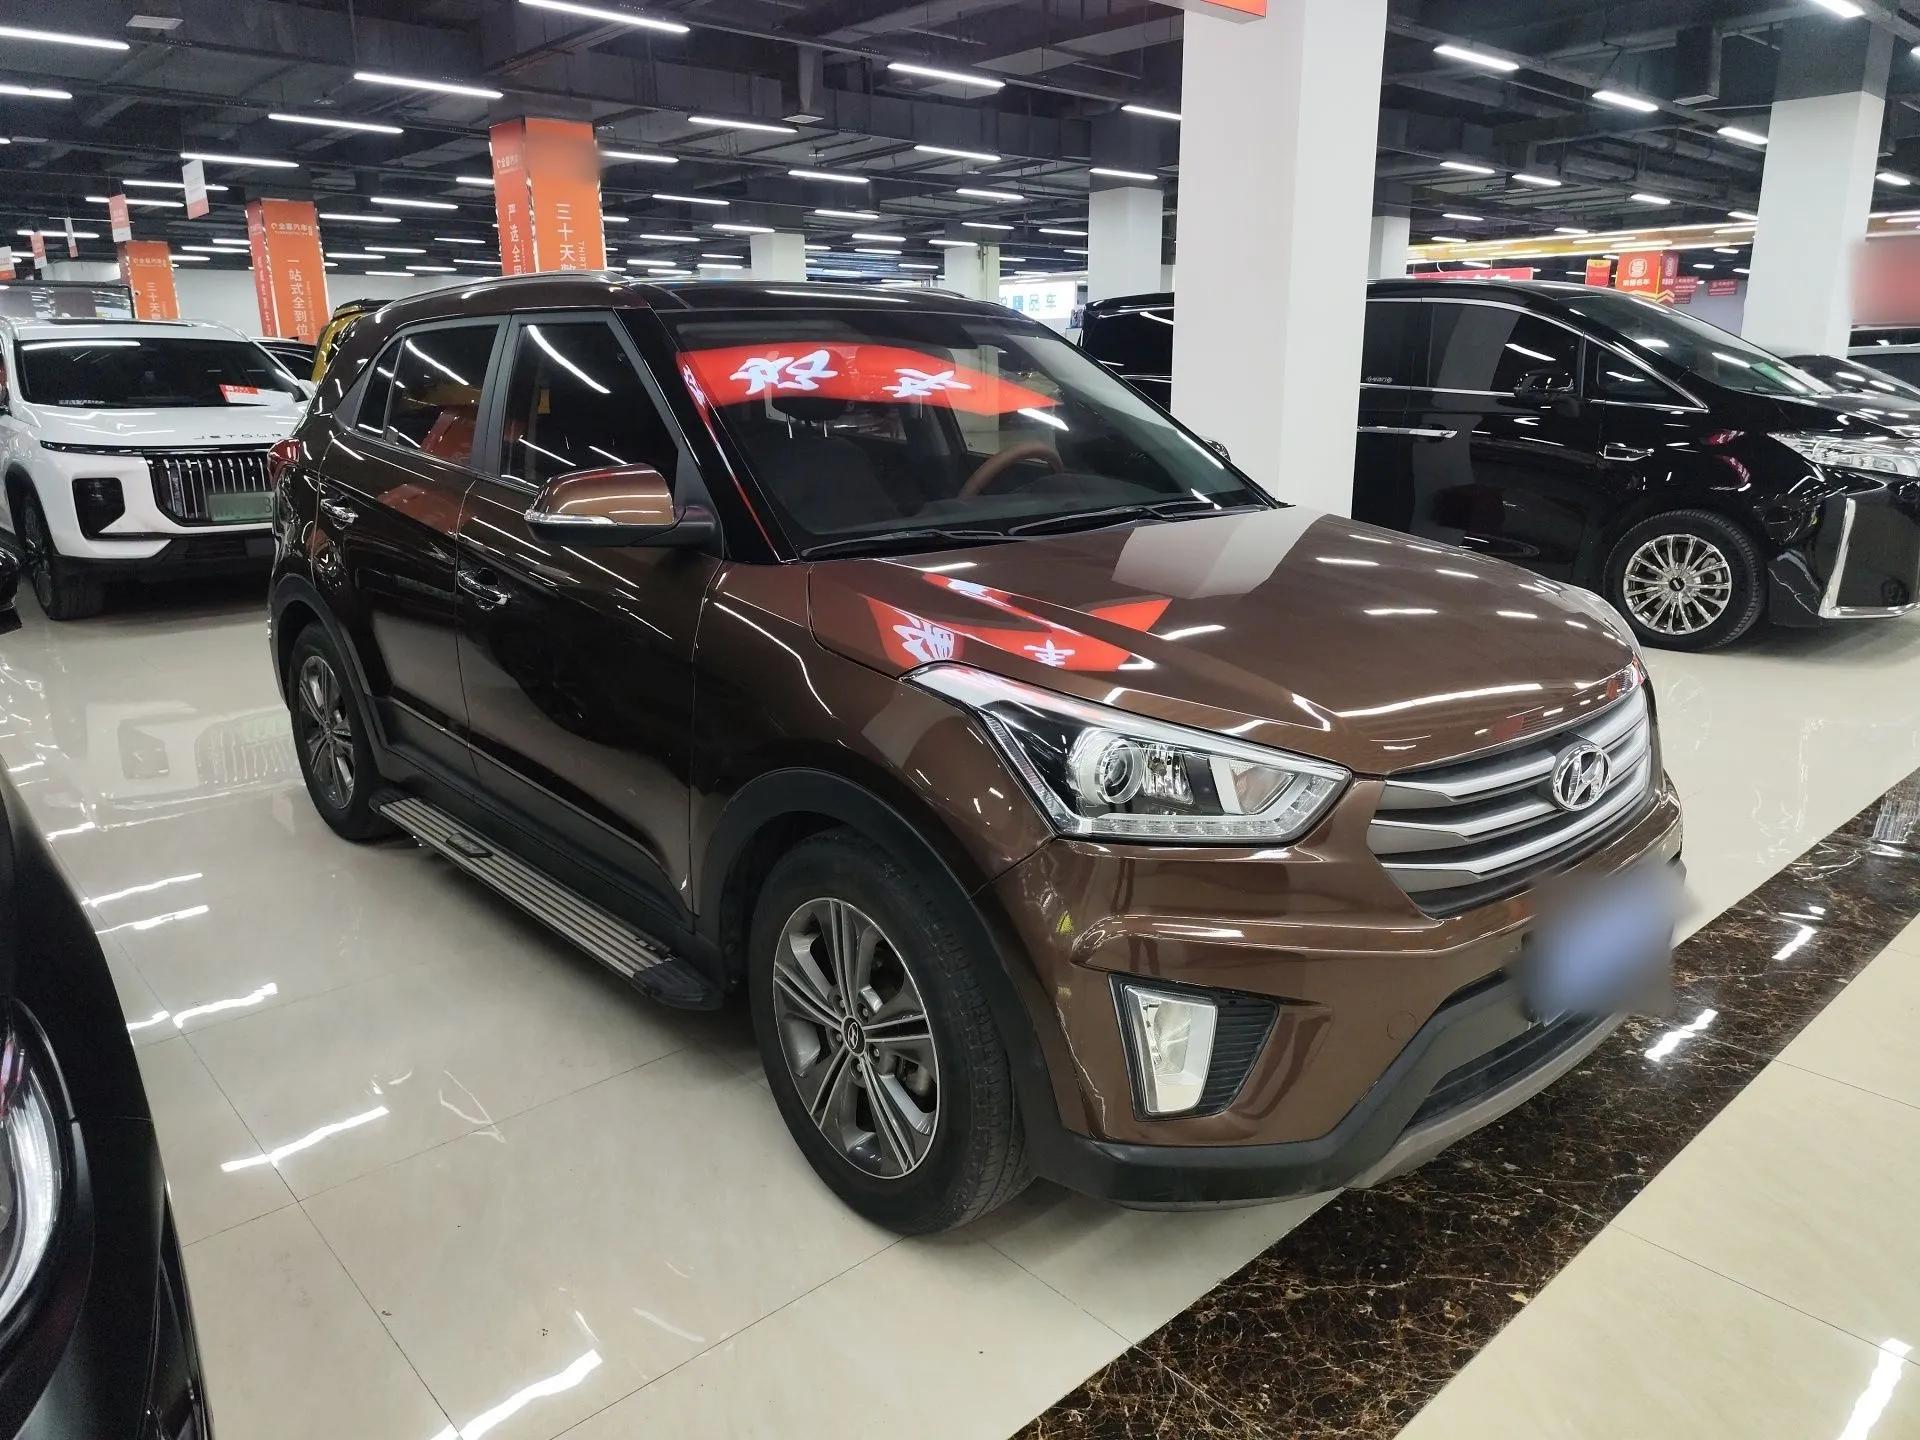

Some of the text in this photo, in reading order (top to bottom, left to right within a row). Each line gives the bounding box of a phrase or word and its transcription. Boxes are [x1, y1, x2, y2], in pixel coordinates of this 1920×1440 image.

[287, 259, 310, 337] 一站式全到位
[192, 432, 283, 440] JETOUR
